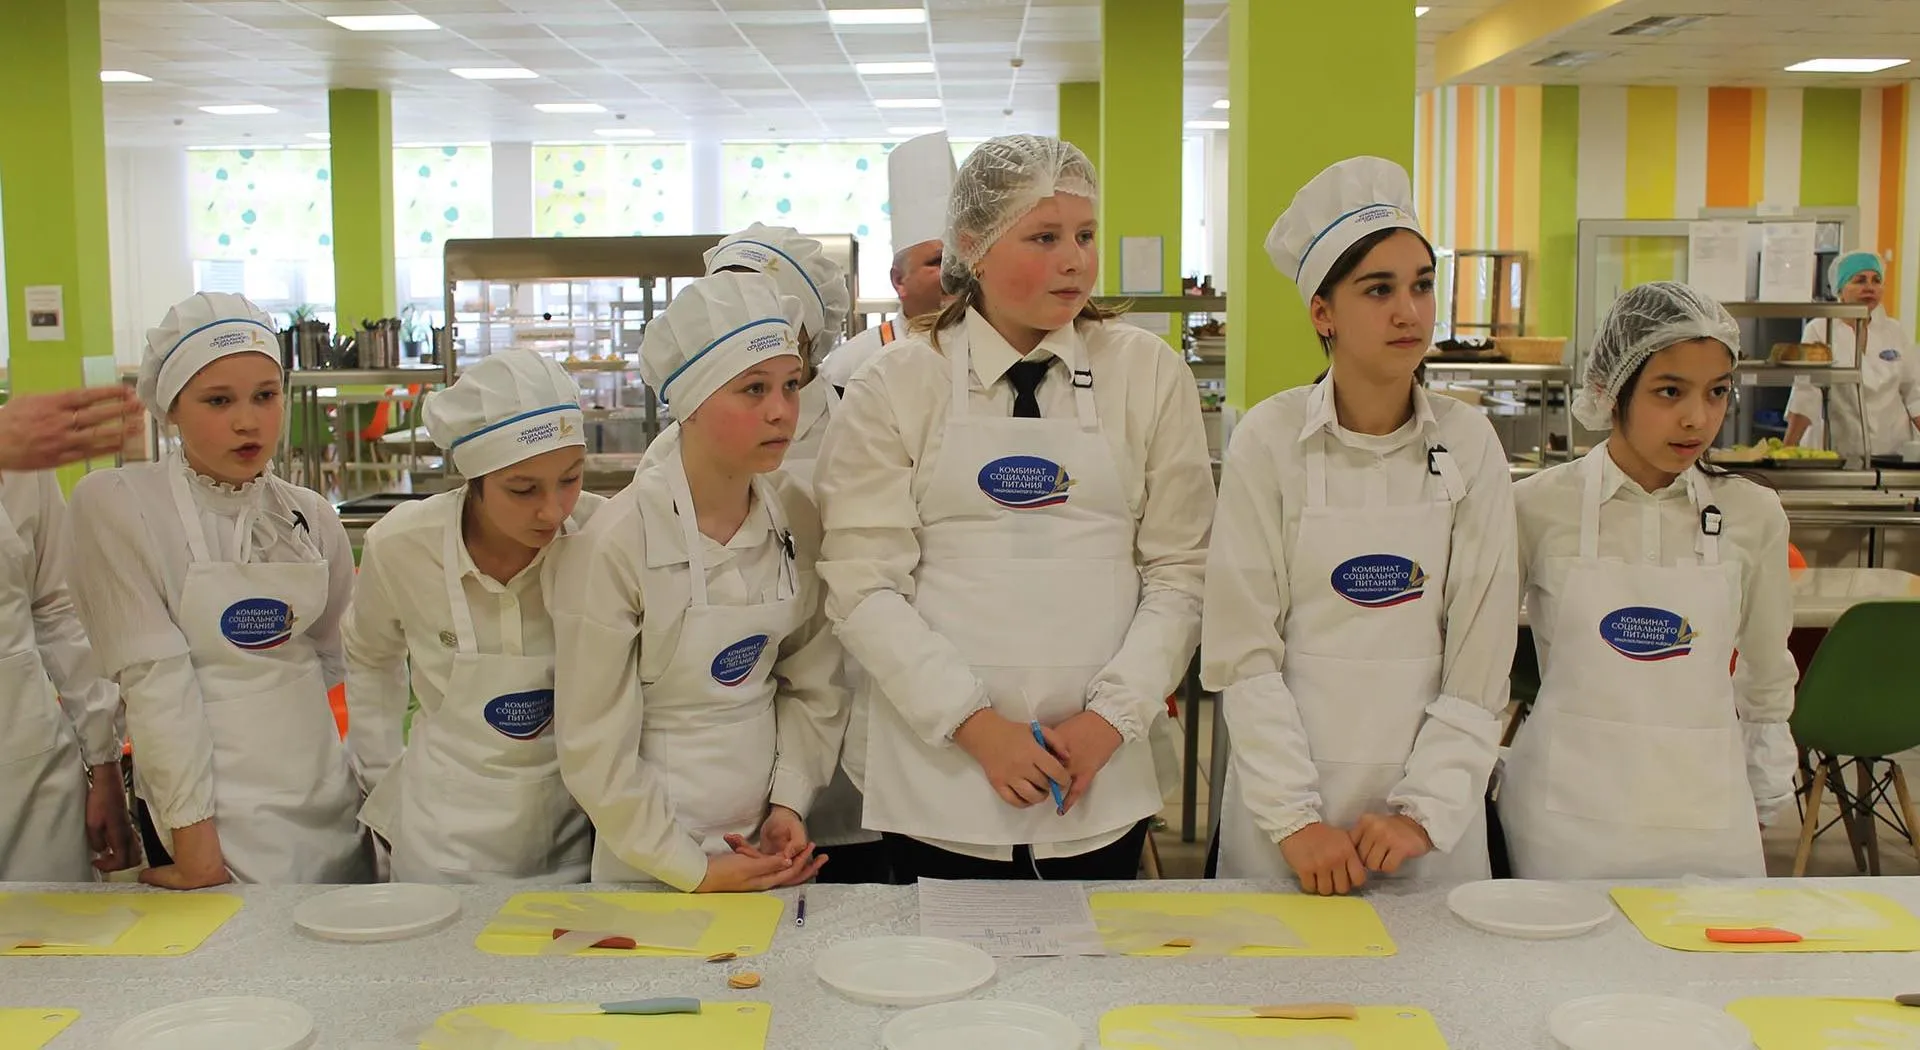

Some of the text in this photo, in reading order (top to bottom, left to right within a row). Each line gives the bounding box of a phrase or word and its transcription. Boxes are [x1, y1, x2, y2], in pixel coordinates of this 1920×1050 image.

[999, 466, 1046, 475] КОМБИНАТ
[989, 472, 1054, 483] СОЦИАЛЬНОГО
[1001, 480, 1042, 489] ПИТАНИЯ
[1351, 565, 1400, 573] КОМБИНАТ
[1342, 571, 1409, 580] СОЦИАЛЬНОГО
[1355, 579, 1397, 587] ПИТАНИЯ
[236, 608, 279, 616] КОМБИНАТ
[228, 615, 285, 623] СОЦИАЛЬНОГО
[1620, 616, 1669, 627] КОМБИНАТ
[237, 622, 275, 630] ПИТАНИЯ
[1611, 622, 1678, 635] СОЦИАЛЬНОГО
[1623, 630, 1665, 641] ПИТАНИЯ
